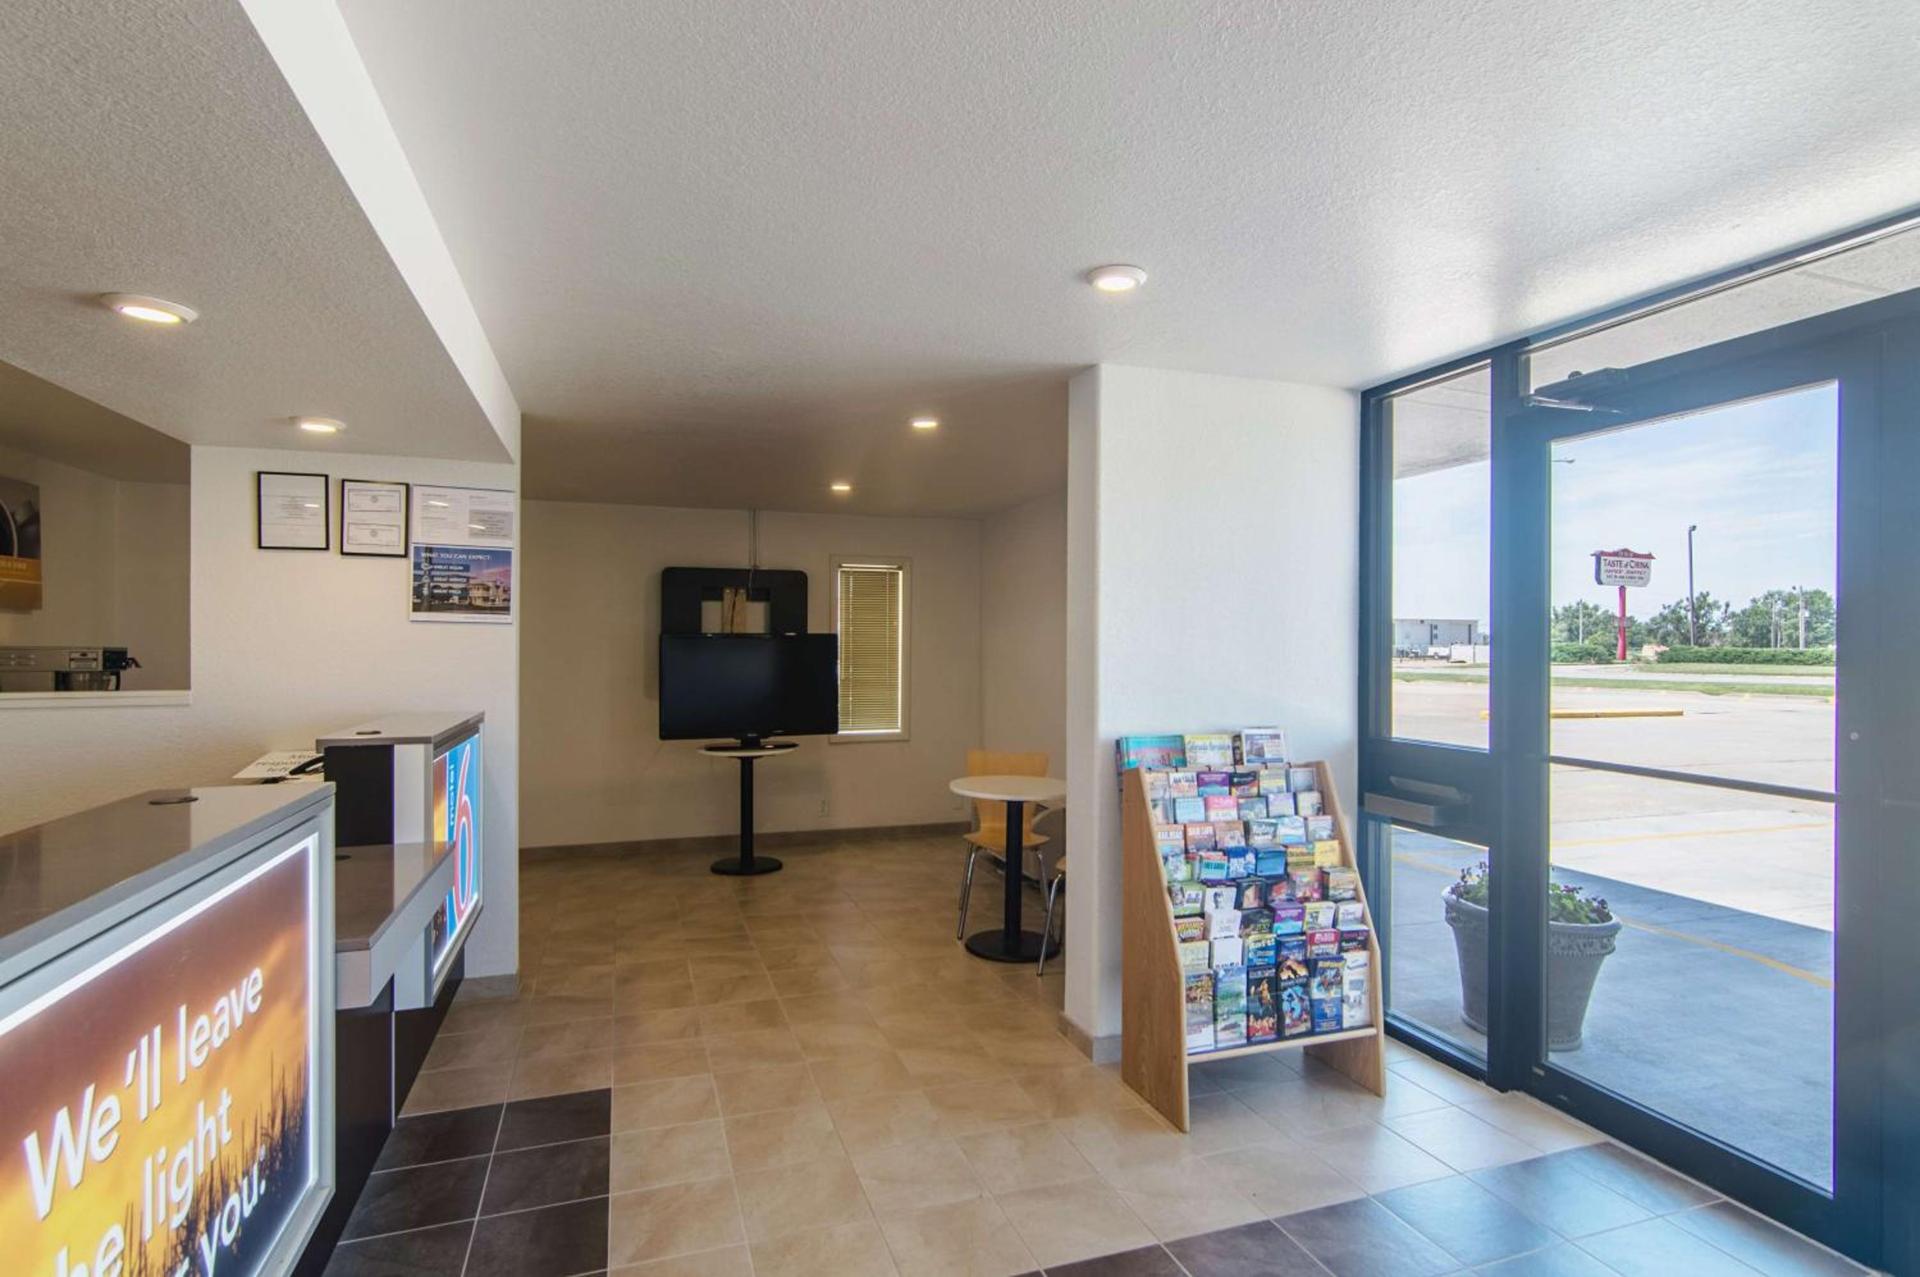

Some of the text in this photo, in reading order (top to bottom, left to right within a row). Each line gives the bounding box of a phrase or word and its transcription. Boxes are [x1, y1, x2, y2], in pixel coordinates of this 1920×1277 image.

[1603, 558, 1623, 568] TASTE
[1630, 560, 1650, 569] CHINA
[453, 743, 473, 928] 6
[23, 966, 264, 1222] We'll leave
[141, 1087, 232, 1244] light
